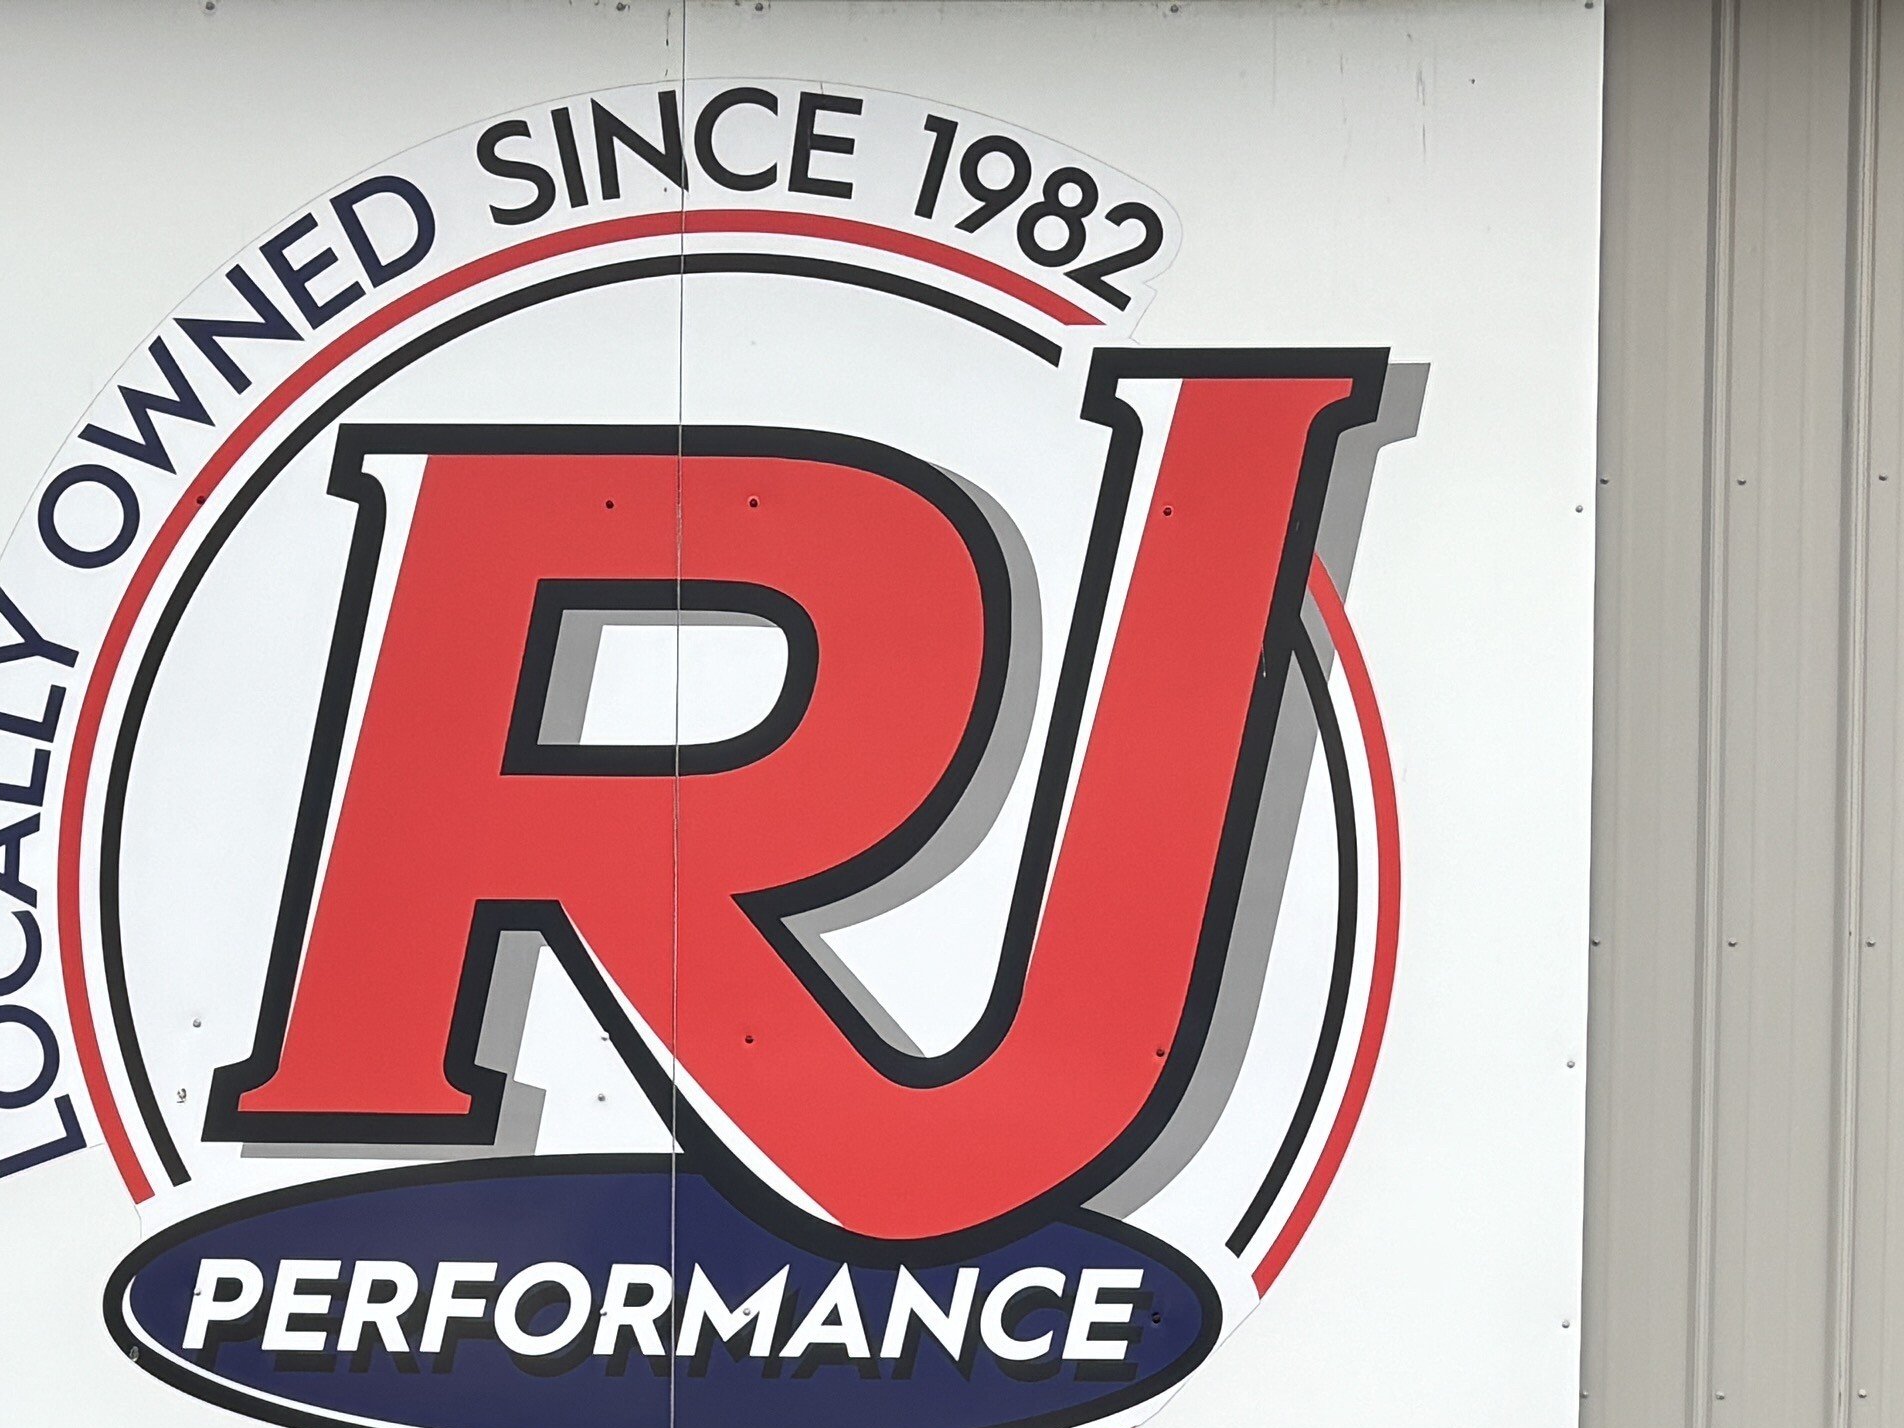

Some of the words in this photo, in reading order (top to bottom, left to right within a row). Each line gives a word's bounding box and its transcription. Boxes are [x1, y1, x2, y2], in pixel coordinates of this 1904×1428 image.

[37, 175, 436, 570] OWNED
[476, 86, 864, 226] SINCE
[914, 113, 1164, 312] 1982
[201, 346, 1392, 1260] RJ
[182, 1258, 1144, 1361] PERFORMANCE
